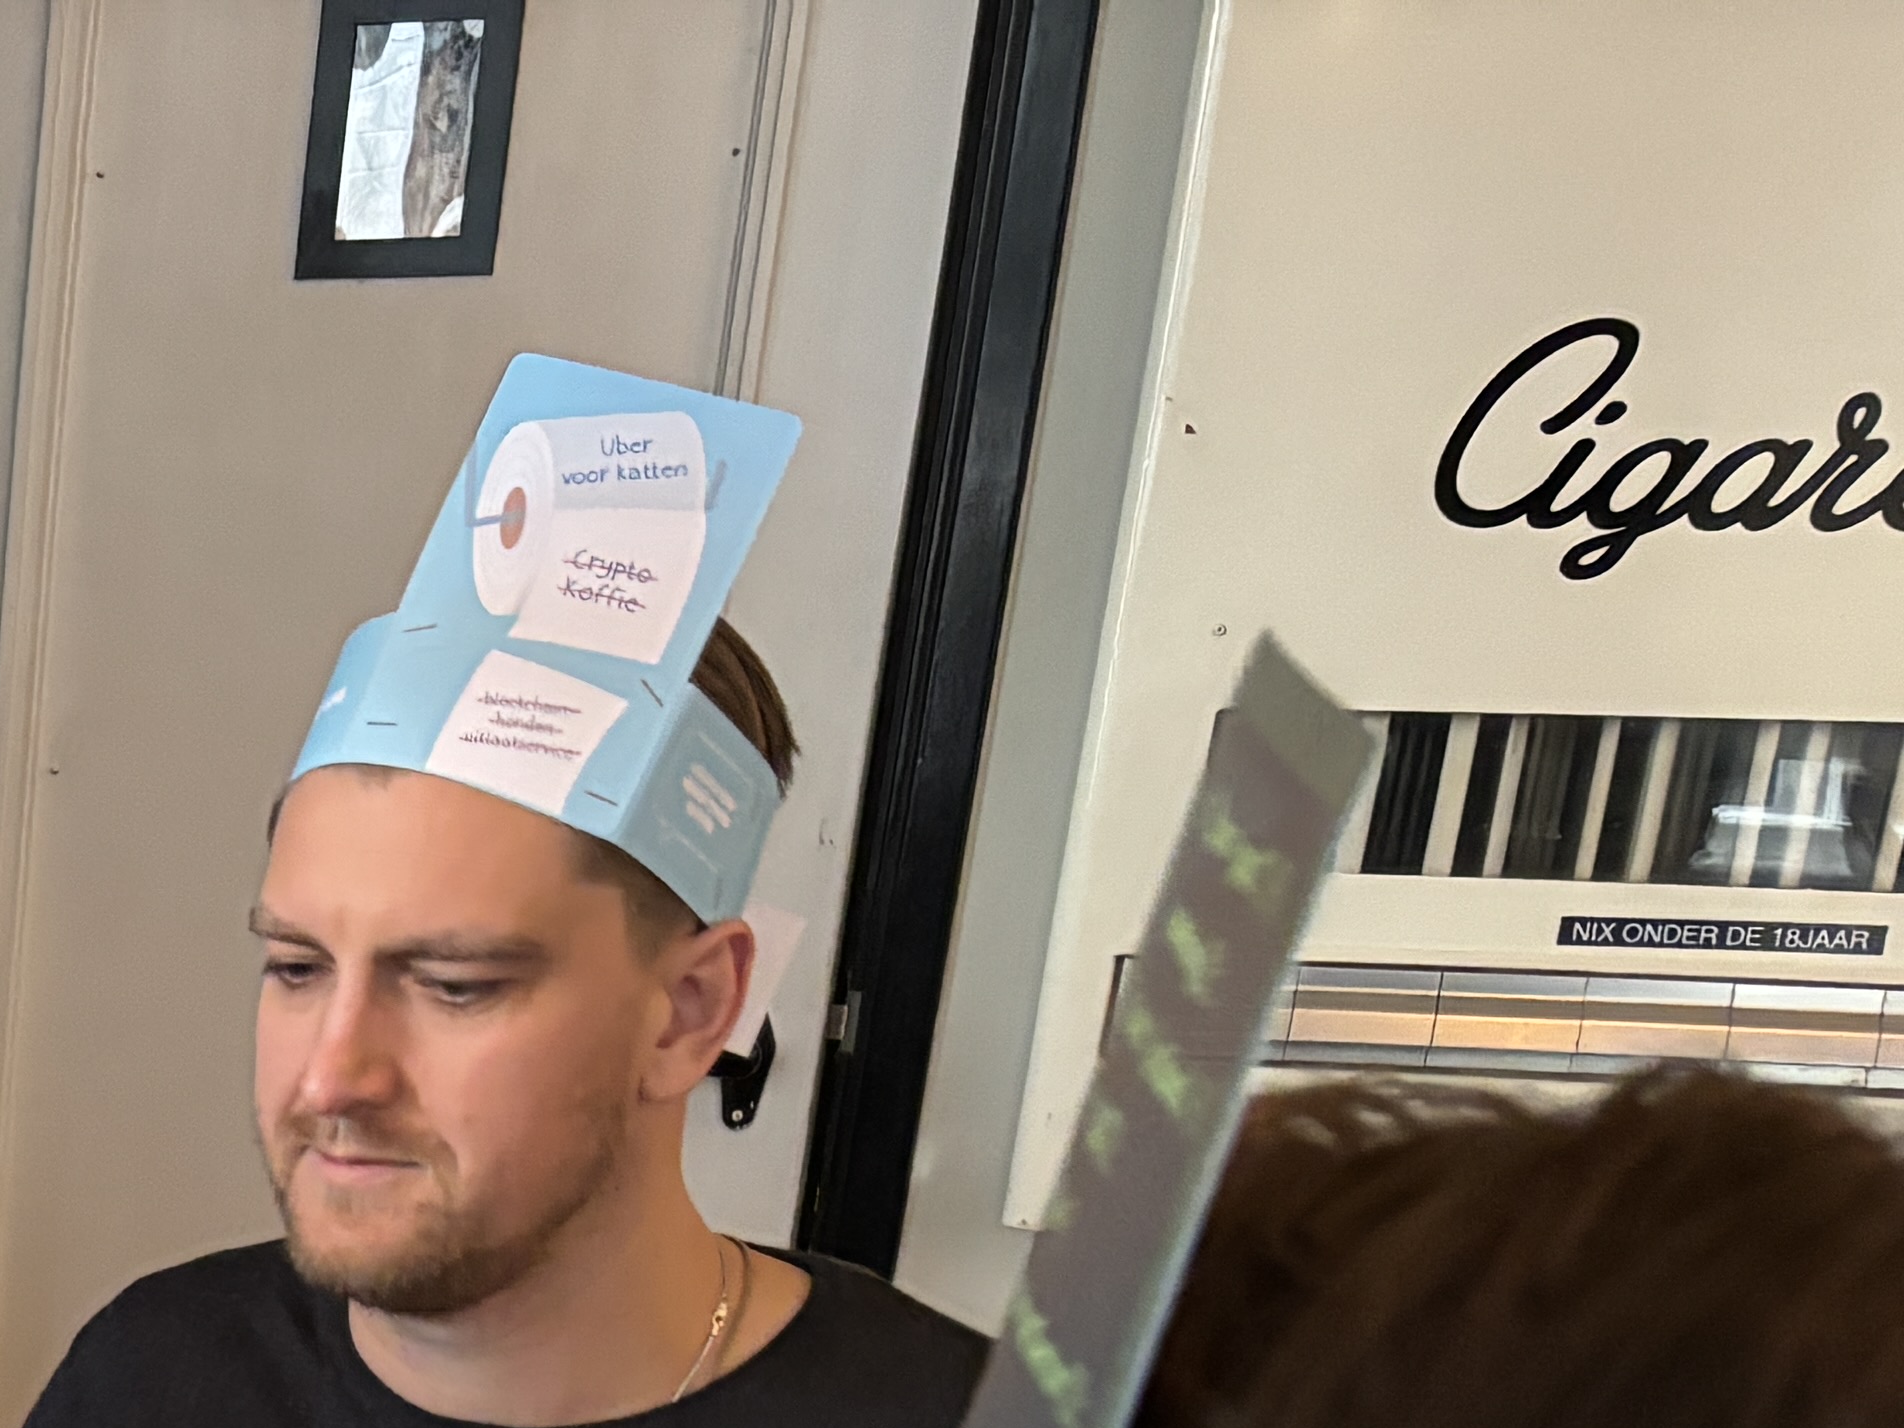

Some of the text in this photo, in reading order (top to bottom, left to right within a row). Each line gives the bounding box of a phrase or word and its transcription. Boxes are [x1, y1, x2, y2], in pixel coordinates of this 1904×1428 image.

[562, 461, 689, 485] voor katten
[1571, 921, 1871, 953] NIX ONDER DE 18JAAR
